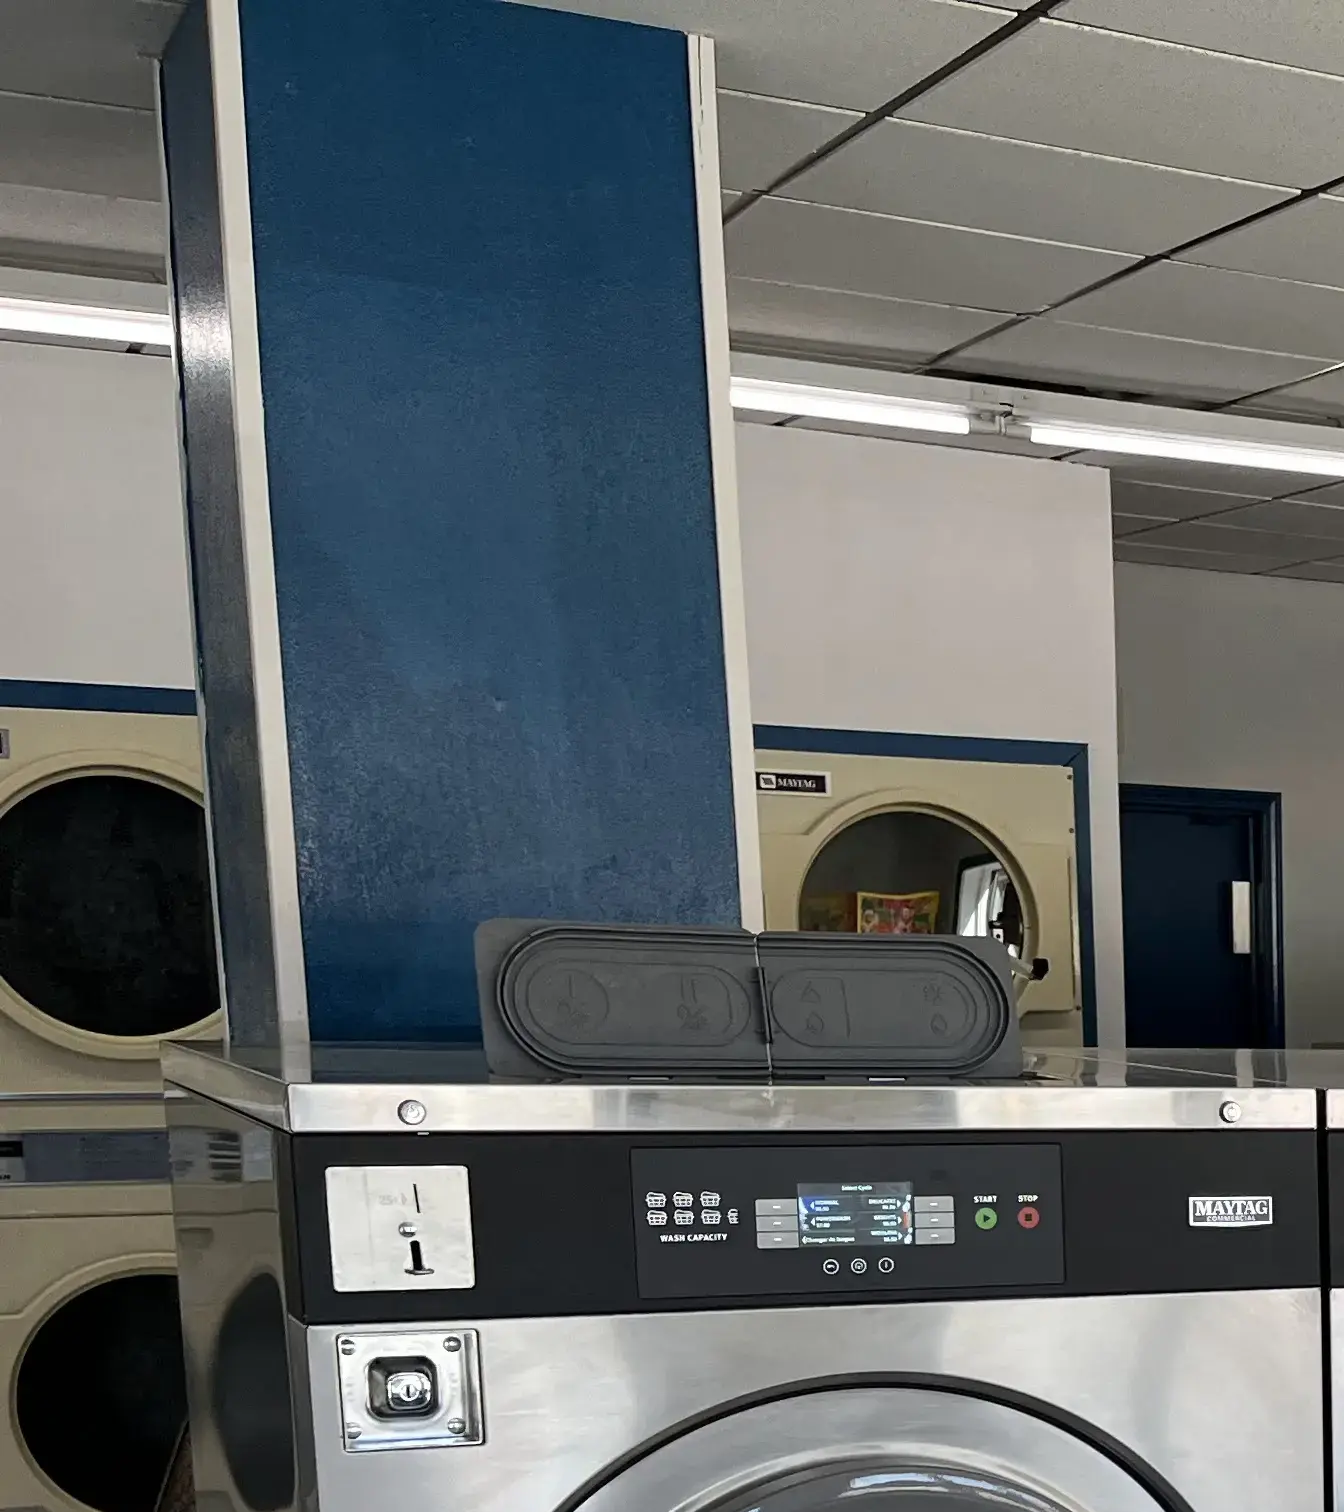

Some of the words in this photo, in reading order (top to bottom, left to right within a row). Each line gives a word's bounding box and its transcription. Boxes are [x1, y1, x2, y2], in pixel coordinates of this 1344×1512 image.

[777, 778, 816, 788] MAYTAG
[973, 1195, 998, 1203] START
[1017, 1194, 1039, 1202] STOP
[1194, 1200, 1269, 1216] MAYTAG
[660, 1233, 686, 1242] WASH
[687, 1233, 728, 1242] CAPACITY
